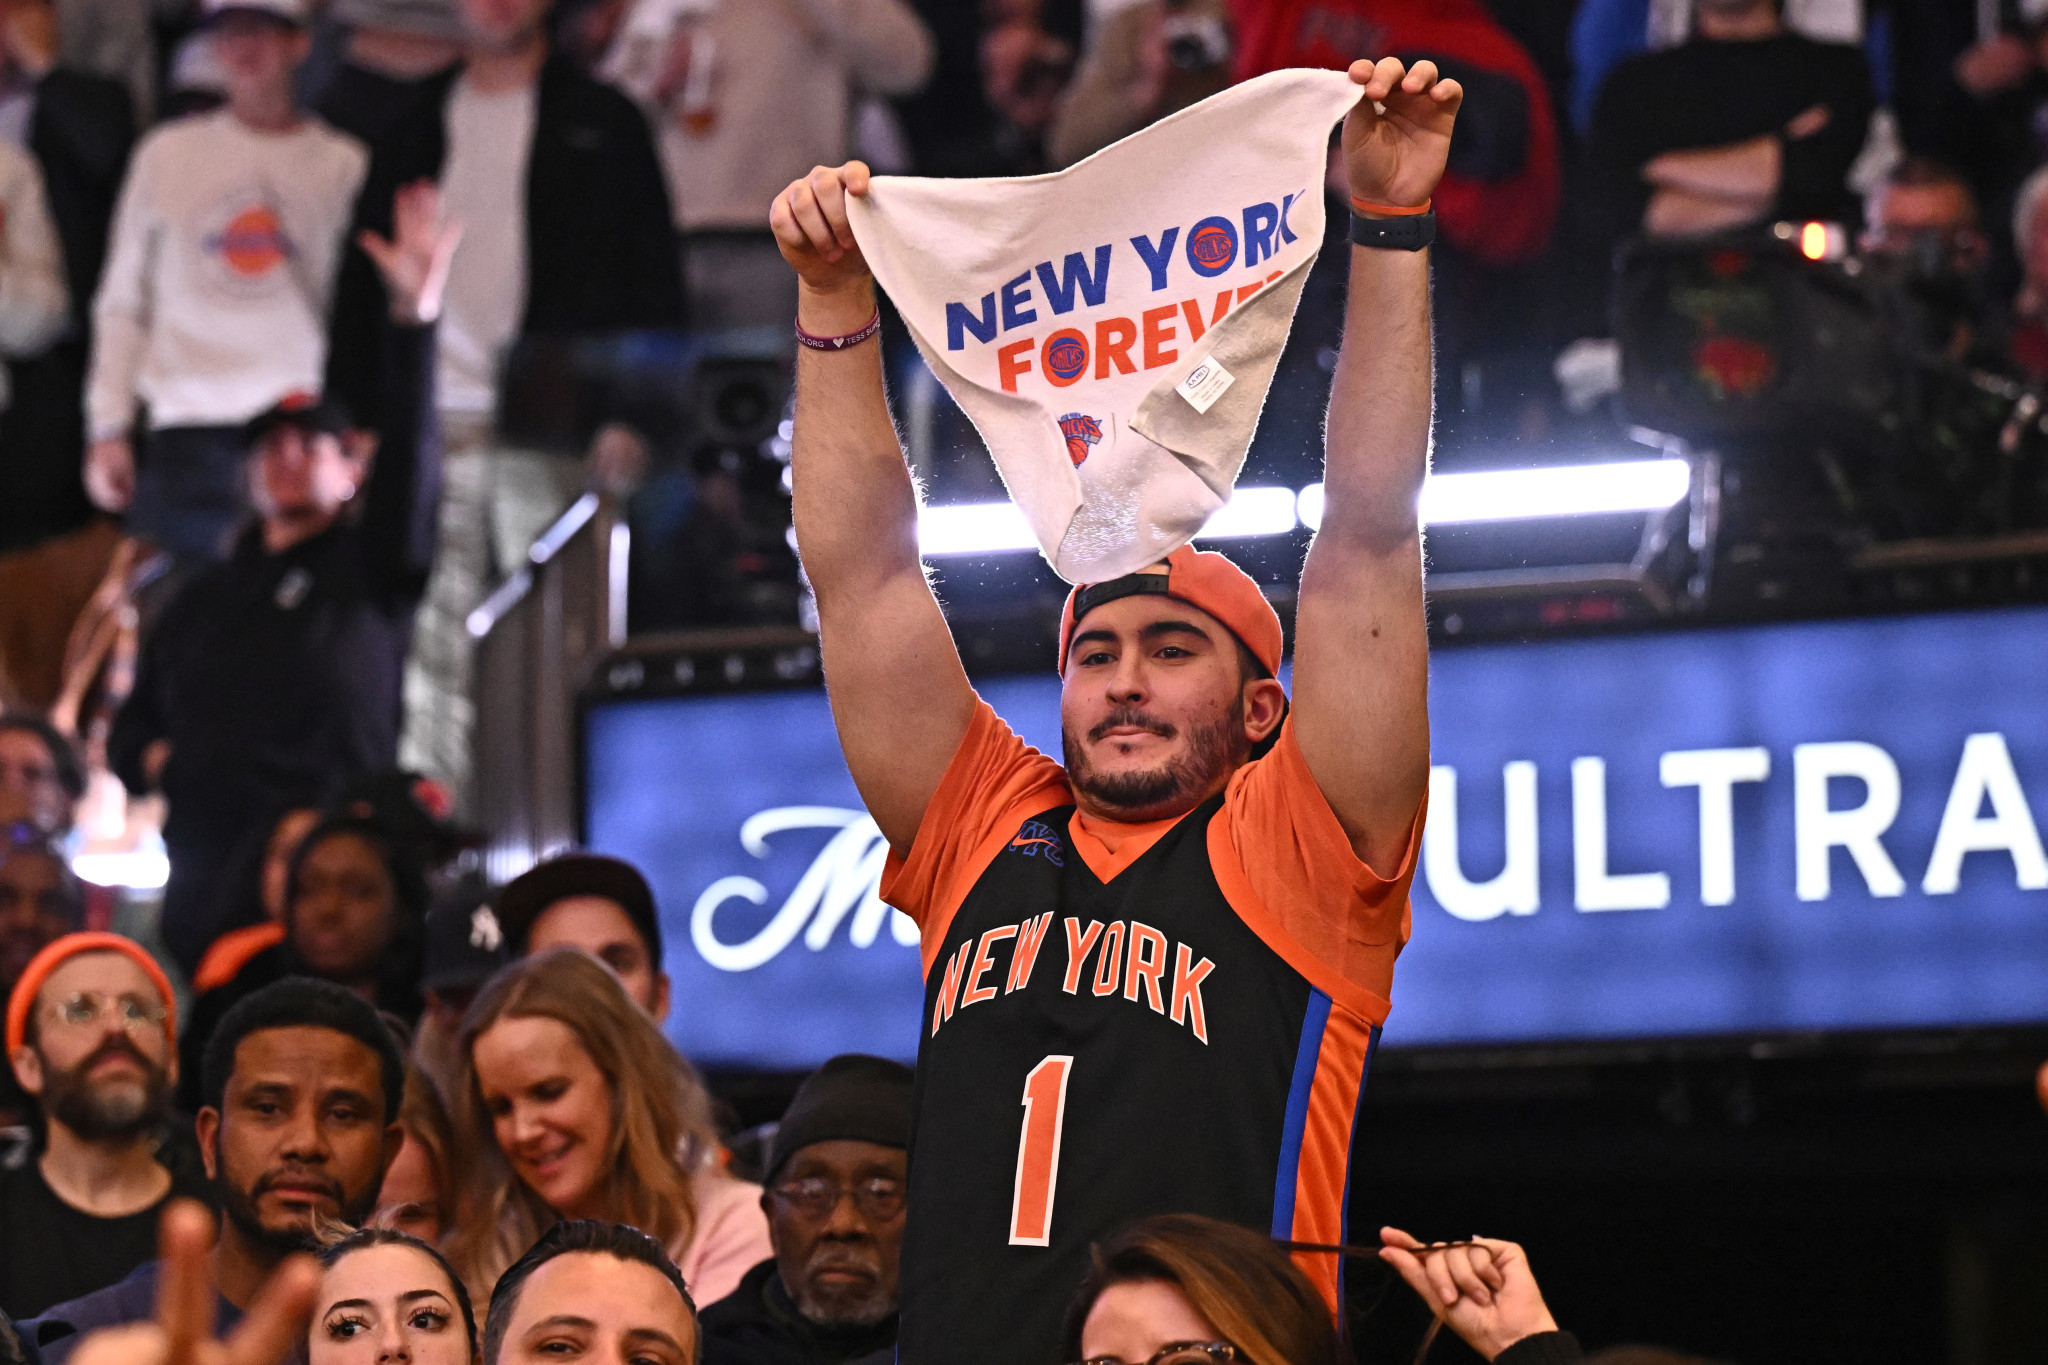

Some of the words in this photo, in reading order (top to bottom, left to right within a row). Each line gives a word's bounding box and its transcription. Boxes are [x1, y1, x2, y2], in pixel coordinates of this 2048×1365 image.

[846, 331, 865, 345] TESS
[945, 244, 1112, 351] NEW
[1129, 189, 1306, 292] YORK
[997, 270, 1286, 394] FOREV
[1424, 732, 2048, 921] ULTRA
[931, 911, 1055, 1039] NEW
[1062, 917, 1216, 1046] YORK
[1008, 1054, 1075, 1247] 1
